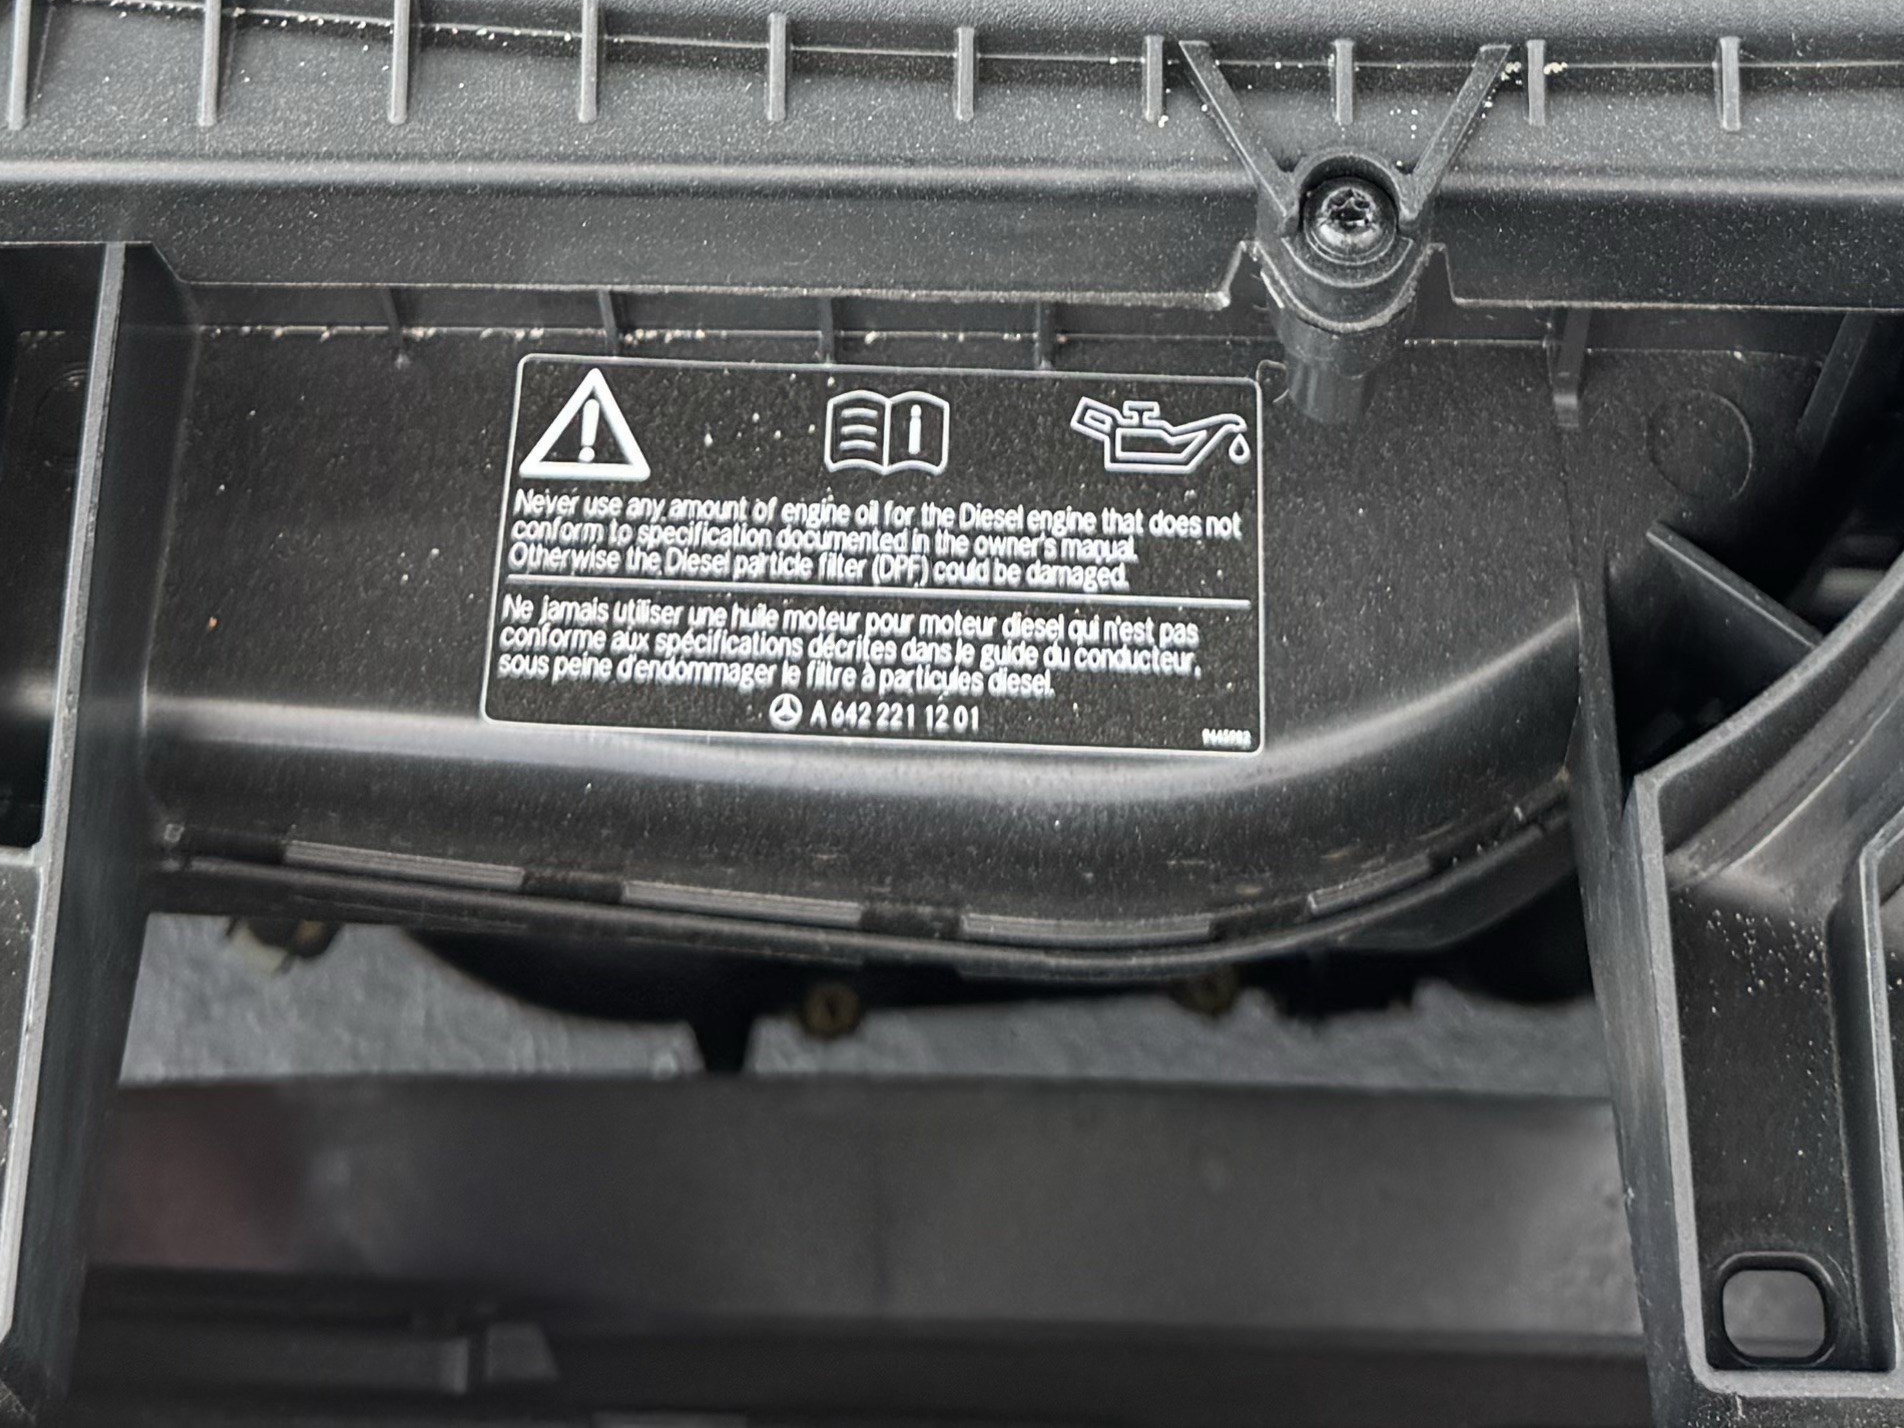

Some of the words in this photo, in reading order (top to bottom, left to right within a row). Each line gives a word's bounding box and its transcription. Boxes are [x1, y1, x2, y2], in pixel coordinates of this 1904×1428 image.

[514, 488, 580, 518] Never
[584, 496, 622, 518] use
[668, 497, 748, 523] amount
[752, 497, 778, 523] of
[781, 501, 851, 529] engine
[855, 500, 878, 527] oil
[882, 501, 916, 528] for
[921, 502, 955, 529] the
[959, 503, 1024, 532] Diesel
[1027, 505, 1097, 538] engine
[1101, 508, 1143, 536] that
[1148, 510, 1201, 538] does
[1205, 512, 1242, 540] not
[511, 518, 605, 545] conform
[609, 518, 633, 546] to
[637, 521, 773, 552] specification
[775, 524, 911, 555] documented
[912, 528, 930, 555] in
[935, 529, 970, 557] the
[973, 532, 1057, 559] owner's
[507, 543, 621, 574] Otherwise
[627, 546, 662, 575] the
[665, 548, 732, 577] Diesel
[733, 551, 813, 581] particle
[818, 551, 867, 582] filter
[871, 553, 929, 589] (DPF)
[933, 558, 990, 585] could
[993, 560, 1021, 586] be
[1025, 562, 1130, 593] damaged.
[501, 593, 534, 620] Ne
[538, 595, 609, 625] jamais
[613, 599, 684, 627] utiliser
[688, 605, 727, 628] une
[731, 602, 779, 630] huile
[783, 605, 861, 633] moteur
[865, 611, 916, 638] pour
[919, 610, 997, 638] moteur
[1002, 612, 1064, 641] diesel
[1068, 615, 1099, 646] qui
[1103, 616, 1155, 643] n'est
[1159, 621, 1200, 649] pas
[499, 626, 607, 651] conforme
[610, 630, 650, 654] aux
[654, 632, 803, 661] spécifications
[807, 634, 897, 662] décrites
[901, 637, 952, 666] dans
[955, 639, 975, 666] le
[980, 642, 1039, 672] guide
[1043, 645, 1071, 671] du
[498, 653, 550, 680] sous
[552, 654, 613, 685] peine
[616, 658, 777, 694] d'endommager
[781, 660, 801, 689] le
[806, 660, 857, 690] filtre
[861, 663, 875, 692] à
[878, 666, 984, 699] particules
[810, 700, 828, 729] A
[831, 701, 872, 730] 642
[877, 702, 915, 731] 221
[925, 705, 948, 733] 12
[953, 705, 980, 733] 01
